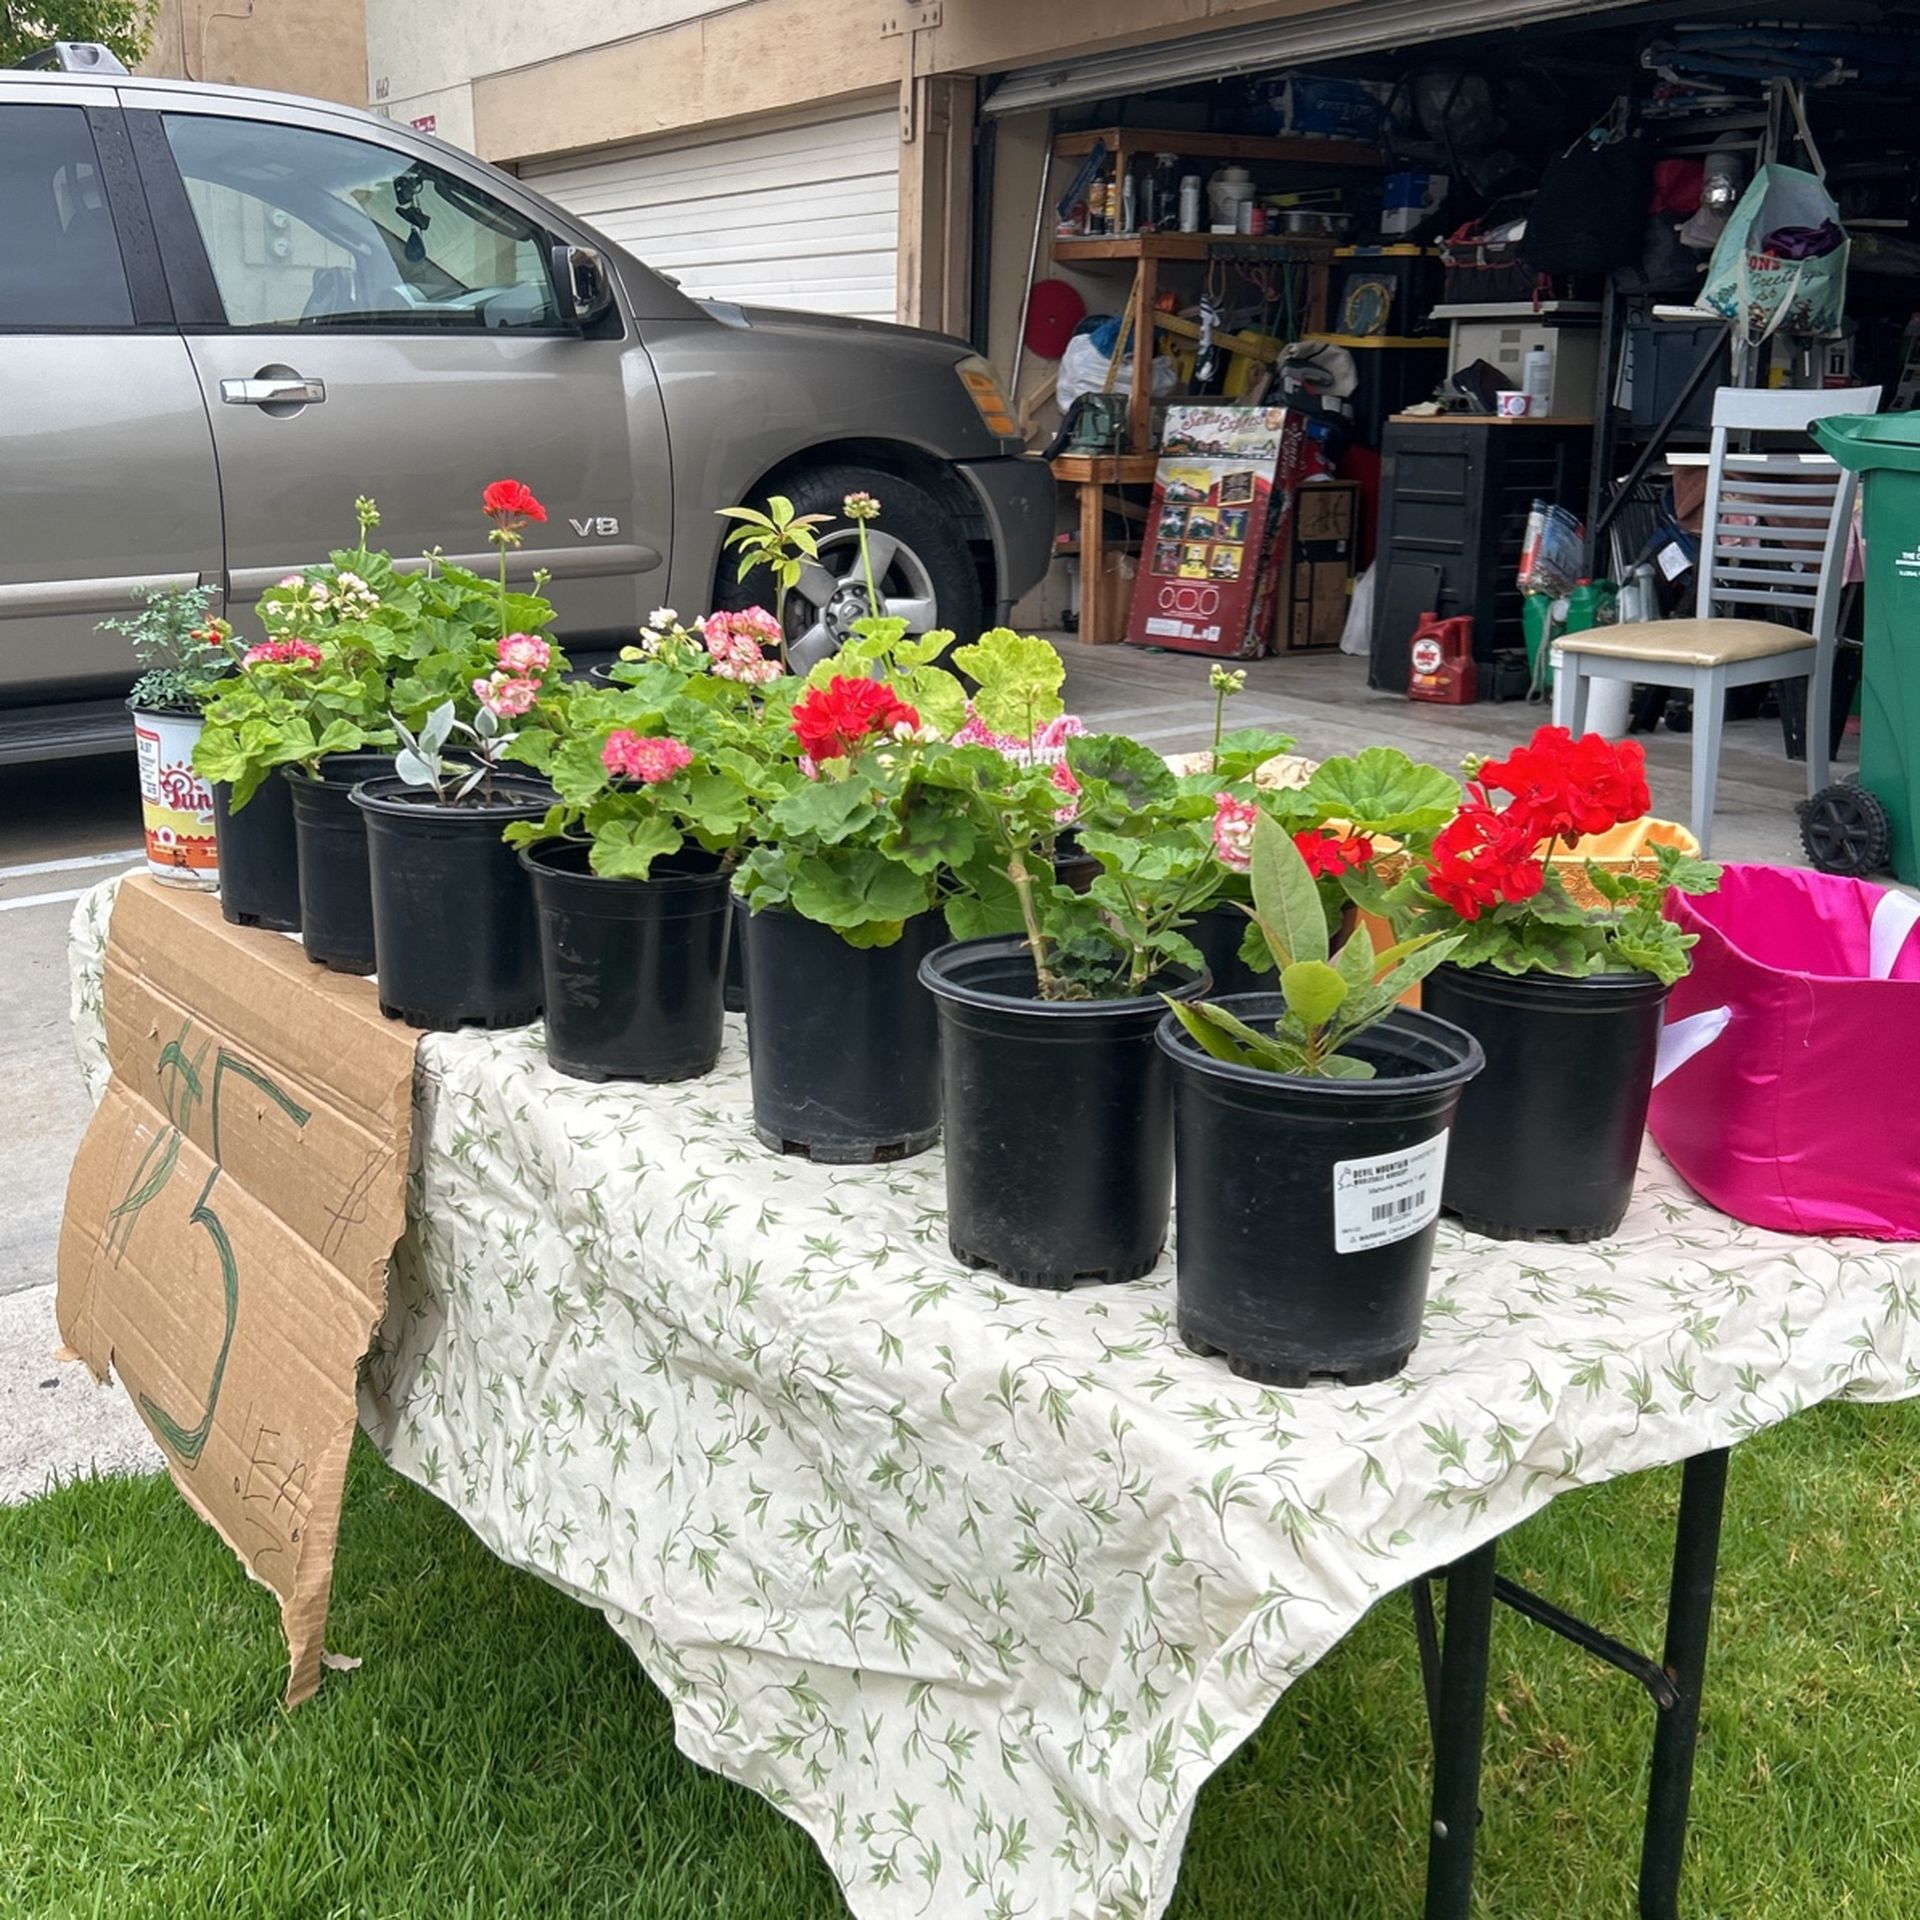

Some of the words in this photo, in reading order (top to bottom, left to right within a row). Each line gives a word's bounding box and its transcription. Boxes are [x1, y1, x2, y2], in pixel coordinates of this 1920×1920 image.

[568, 516, 619, 537] V8
[1353, 1167, 1374, 1179] DEVIL
[1376, 1159, 1408, 1174] MOUNTAIN
